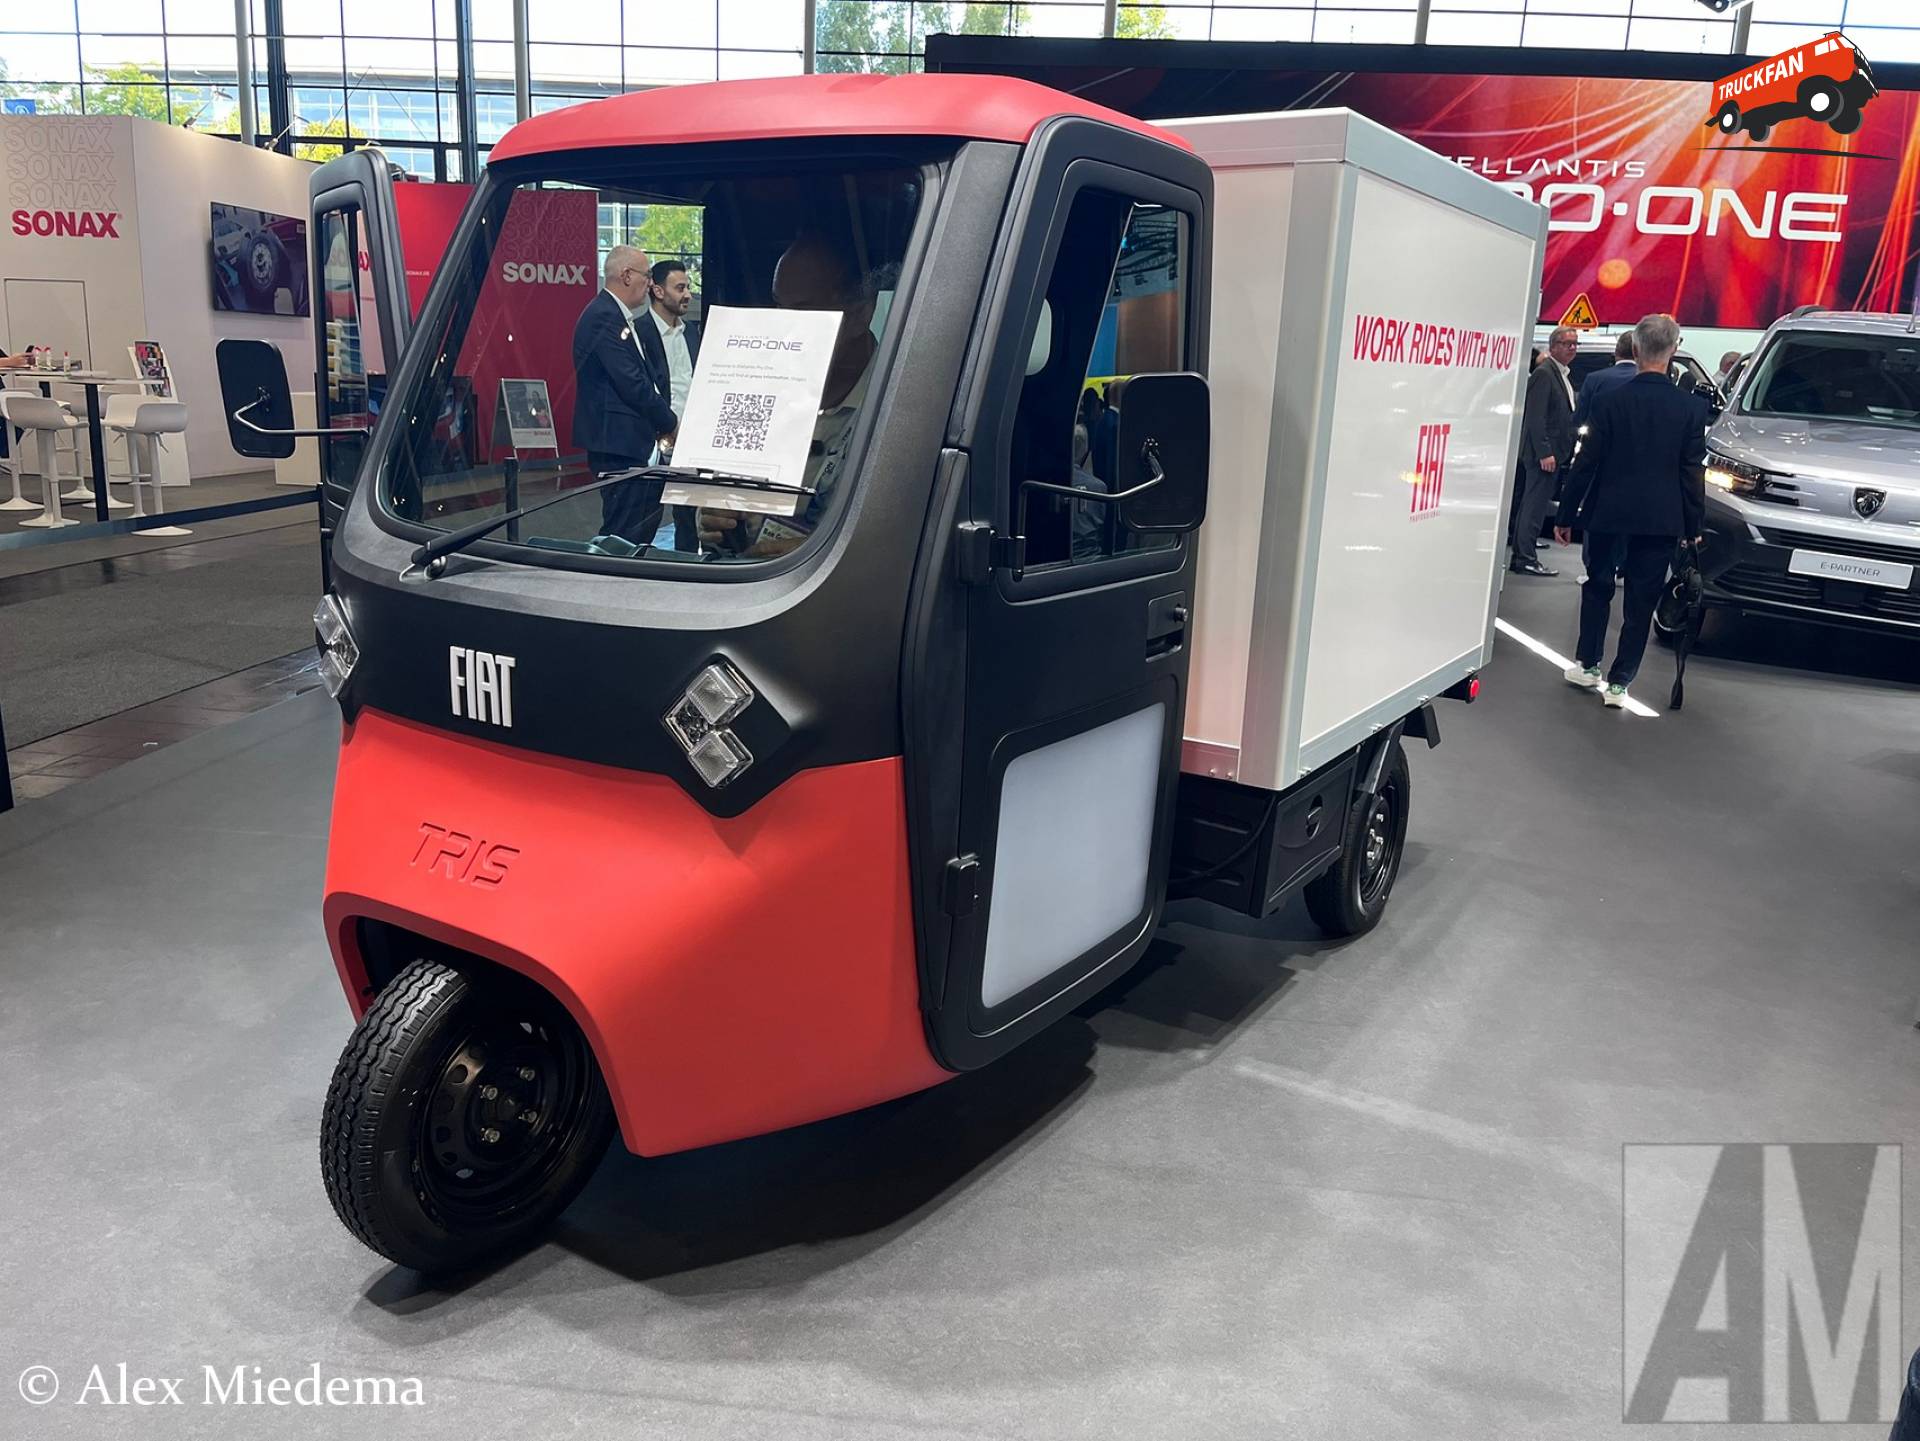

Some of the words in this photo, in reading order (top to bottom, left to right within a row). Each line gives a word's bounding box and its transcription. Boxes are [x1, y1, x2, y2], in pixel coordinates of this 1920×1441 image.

[4, 125, 114, 154] SONAX
[6, 152, 116, 182] SONAX
[1444, 155, 1648, 179] ELLANTIS
[8, 180, 119, 211] SONAX
[12, 210, 119, 239] SONAX
[502, 261, 587, 285] SONAX
[1353, 314, 1410, 363] WORK
[1408, 322, 1455, 367] RIDES
[1455, 329, 1489, 369] WITH
[1490, 335, 1516, 371] YOU
[1411, 424, 1451, 513] FIAT
[1820, 561, 1881, 577] E-PARTNER
[450, 645, 516, 728] FIAT
[410, 822, 521, 890] TRIS
